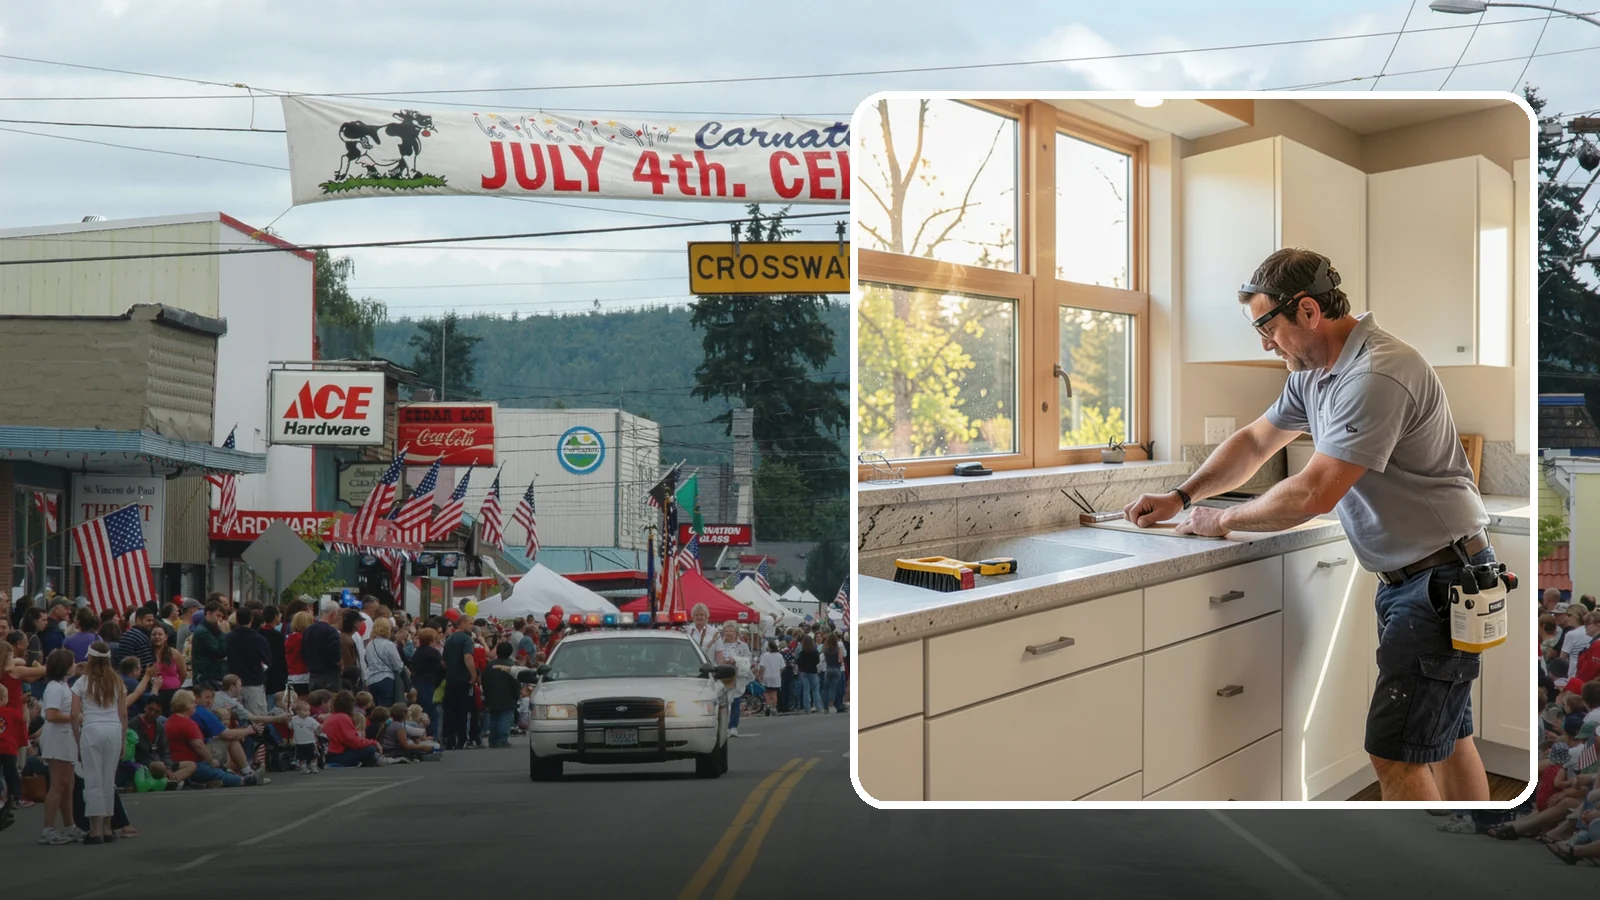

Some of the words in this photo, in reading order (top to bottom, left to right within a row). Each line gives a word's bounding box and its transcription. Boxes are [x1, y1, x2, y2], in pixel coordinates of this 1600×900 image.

[481, 141, 605, 192] JULY
[632, 150, 747, 198] 4th.
[696, 253, 850, 280] CROSSWA
[283, 380, 374, 420] ACE
[405, 409, 453, 422] CEDAR
[283, 421, 371, 437] Hardware
[416, 428, 477, 447] Coca-Cola
[353, 467, 389, 481] Simpl
[83, 485, 94, 494] St.
[95, 485, 124, 495] Vincent
[126, 486, 136, 495] de
[138, 486, 155, 495] Paul
[81, 503, 154, 522] THRT
[688, 526, 742, 535] CRNATION
[698, 535, 730, 543] GLASS
